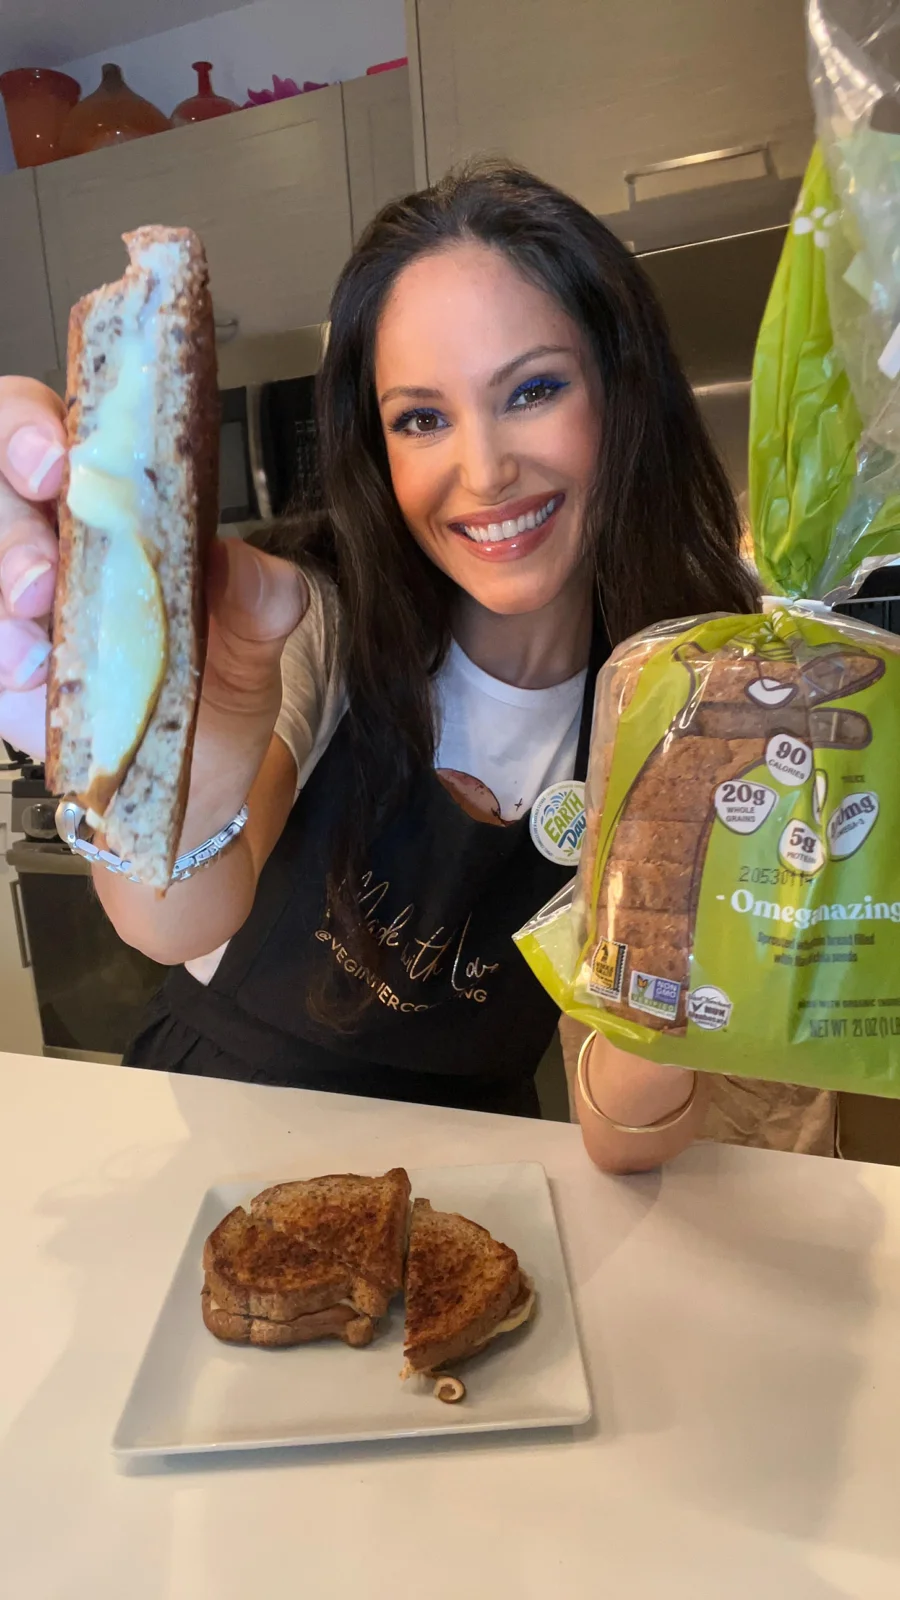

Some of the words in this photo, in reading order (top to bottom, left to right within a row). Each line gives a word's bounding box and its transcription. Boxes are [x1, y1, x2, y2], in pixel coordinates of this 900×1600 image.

[776, 741, 807, 766] 90
[768, 759, 805, 780] CALORIES
[722, 784, 766, 806] 20g
[543, 789, 585, 844] EARTH
[725, 814, 756, 823] GRAINS
[726, 806, 756, 815] WHOLE
[789, 827, 817, 853] 5g
[786, 852, 817, 864] PROTEIN
[656, 987, 676, 998] GMO
[657, 981, 677, 992] NON
[810, 1018, 829, 1038] NET
[831, 1018, 848, 1037] WT
[865, 1017, 878, 1037] OZ
